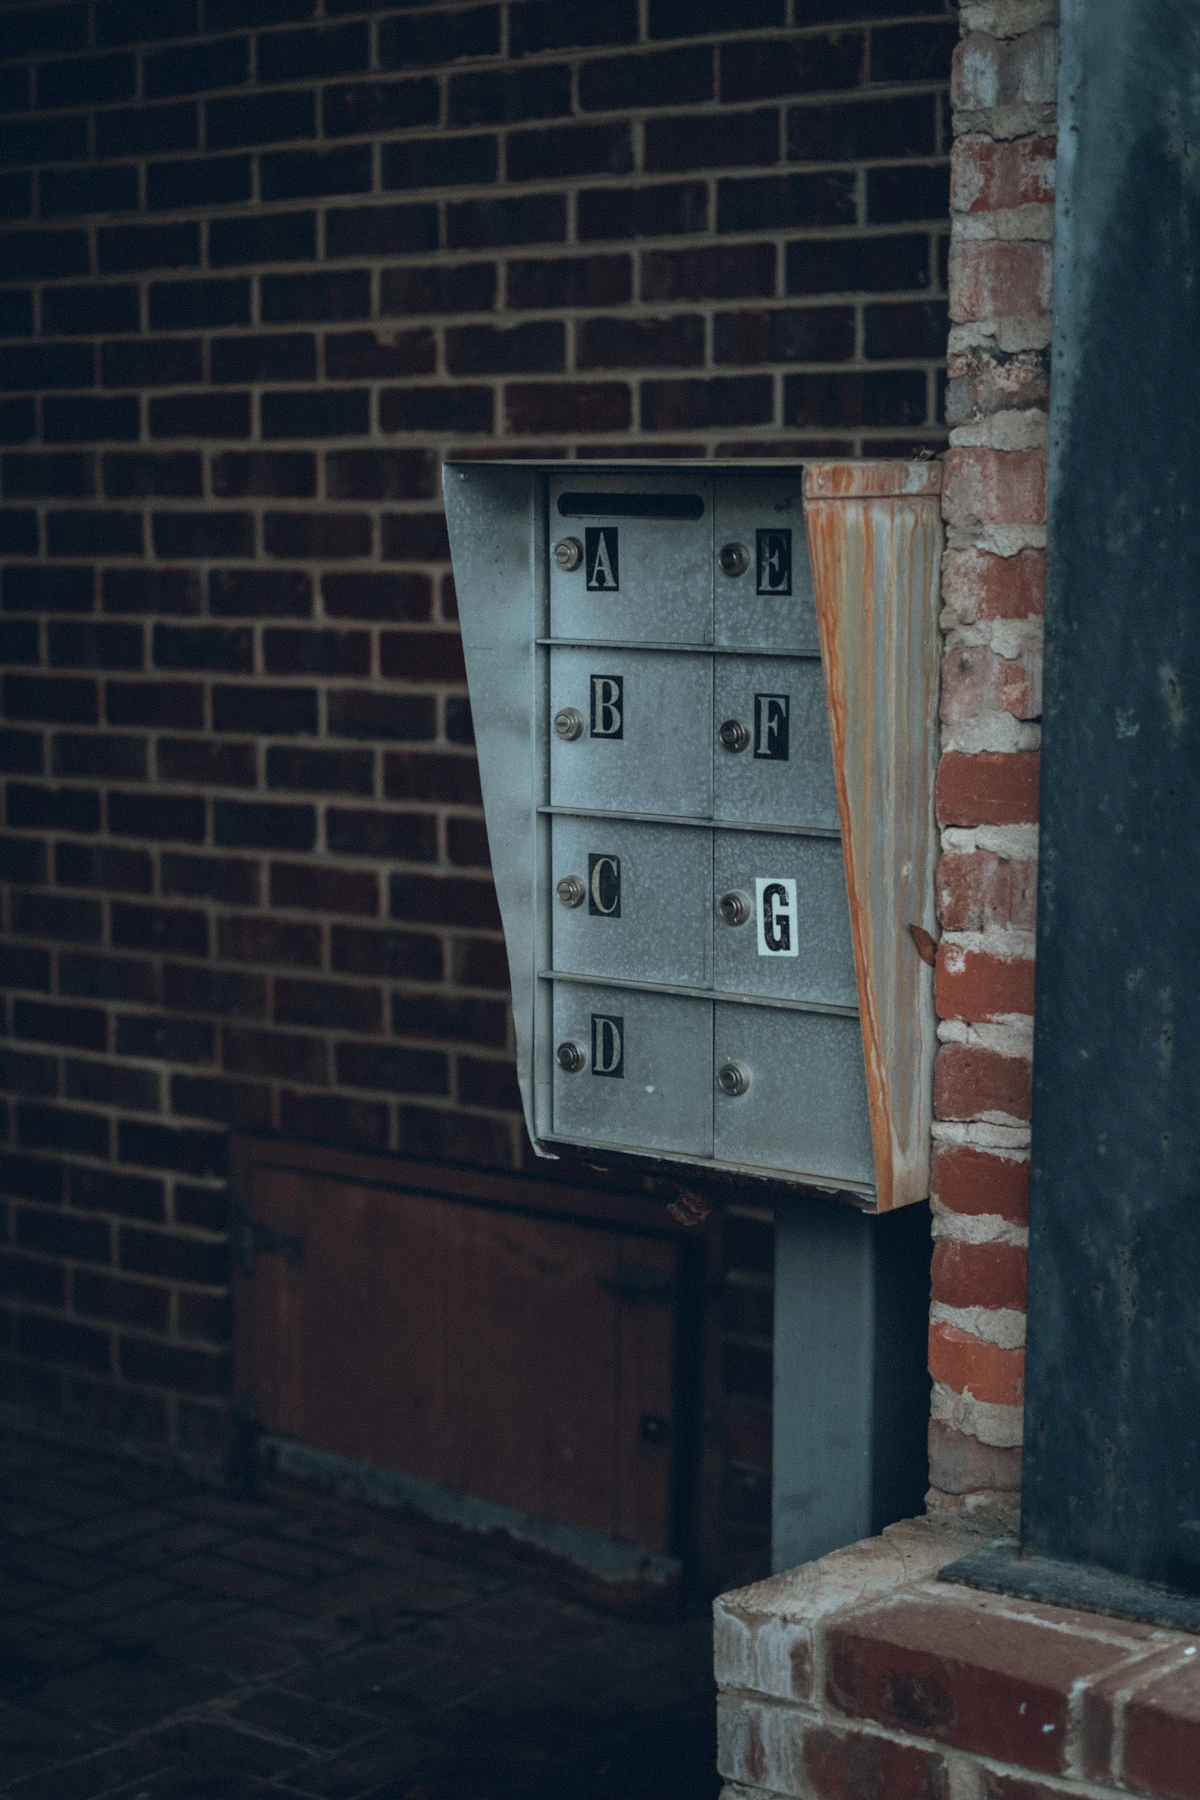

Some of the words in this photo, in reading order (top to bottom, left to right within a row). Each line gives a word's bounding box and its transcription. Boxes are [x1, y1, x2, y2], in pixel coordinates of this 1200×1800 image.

[588, 531, 617, 588] A
[758, 534, 789, 592] E
[592, 678, 622, 735] B
[756, 697, 787, 755] F
[591, 857, 619, 914] C
[762, 882, 791, 952] G
[593, 1017, 622, 1073] D
